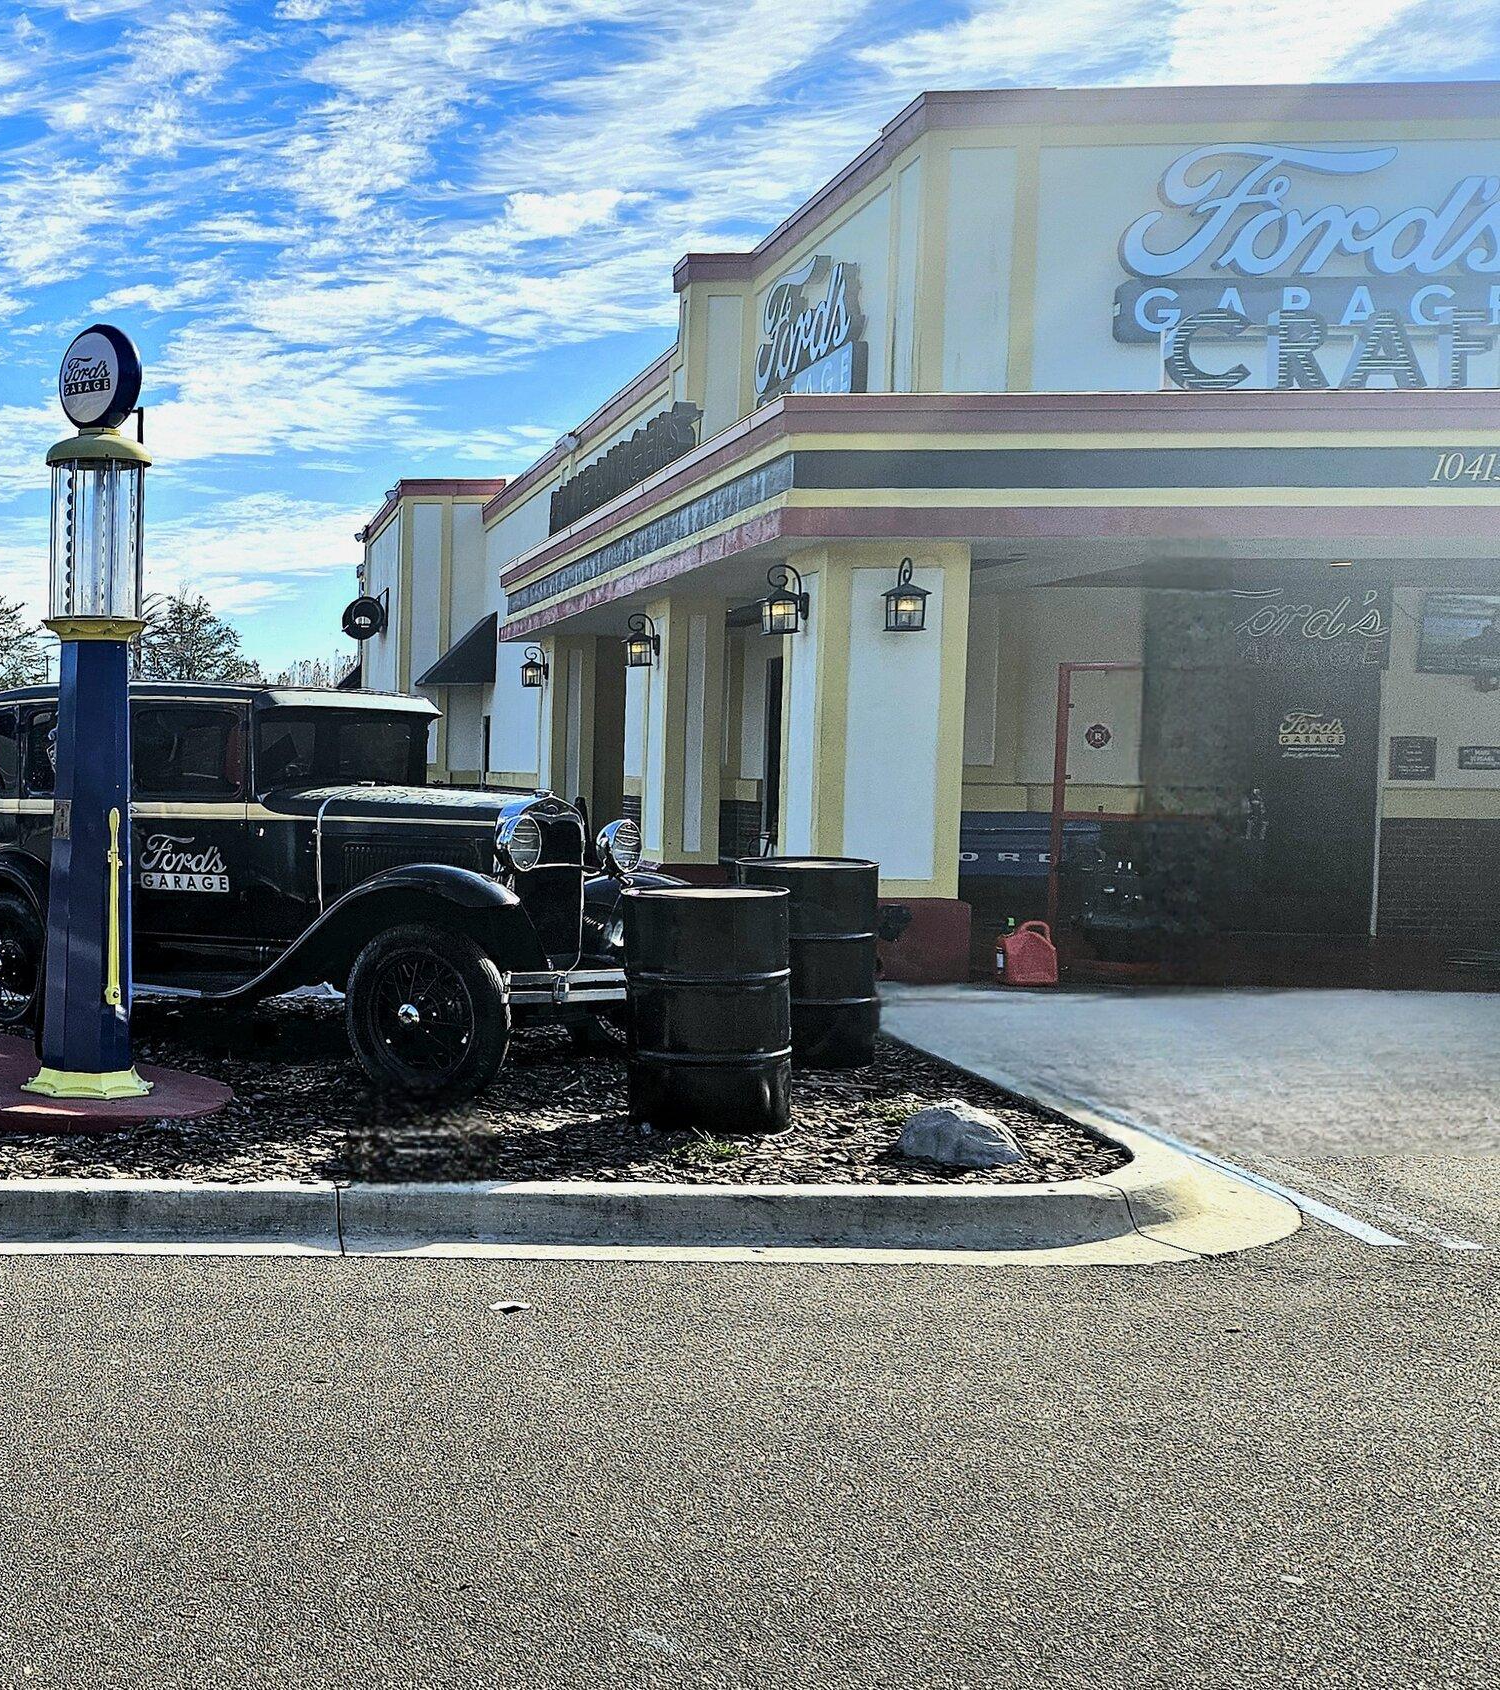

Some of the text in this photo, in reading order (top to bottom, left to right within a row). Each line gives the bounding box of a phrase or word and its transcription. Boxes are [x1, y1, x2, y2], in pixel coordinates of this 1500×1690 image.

[755, 255, 851, 394] Ford's
[63, 357, 110, 383] Ford's
[65, 379, 109, 395] GARAGE
[1231, 588, 1389, 639] ord's
[1281, 735, 1343, 744] GARAGE
[140, 834, 227, 873] Ford's
[143, 874, 227, 891] GARAGE
